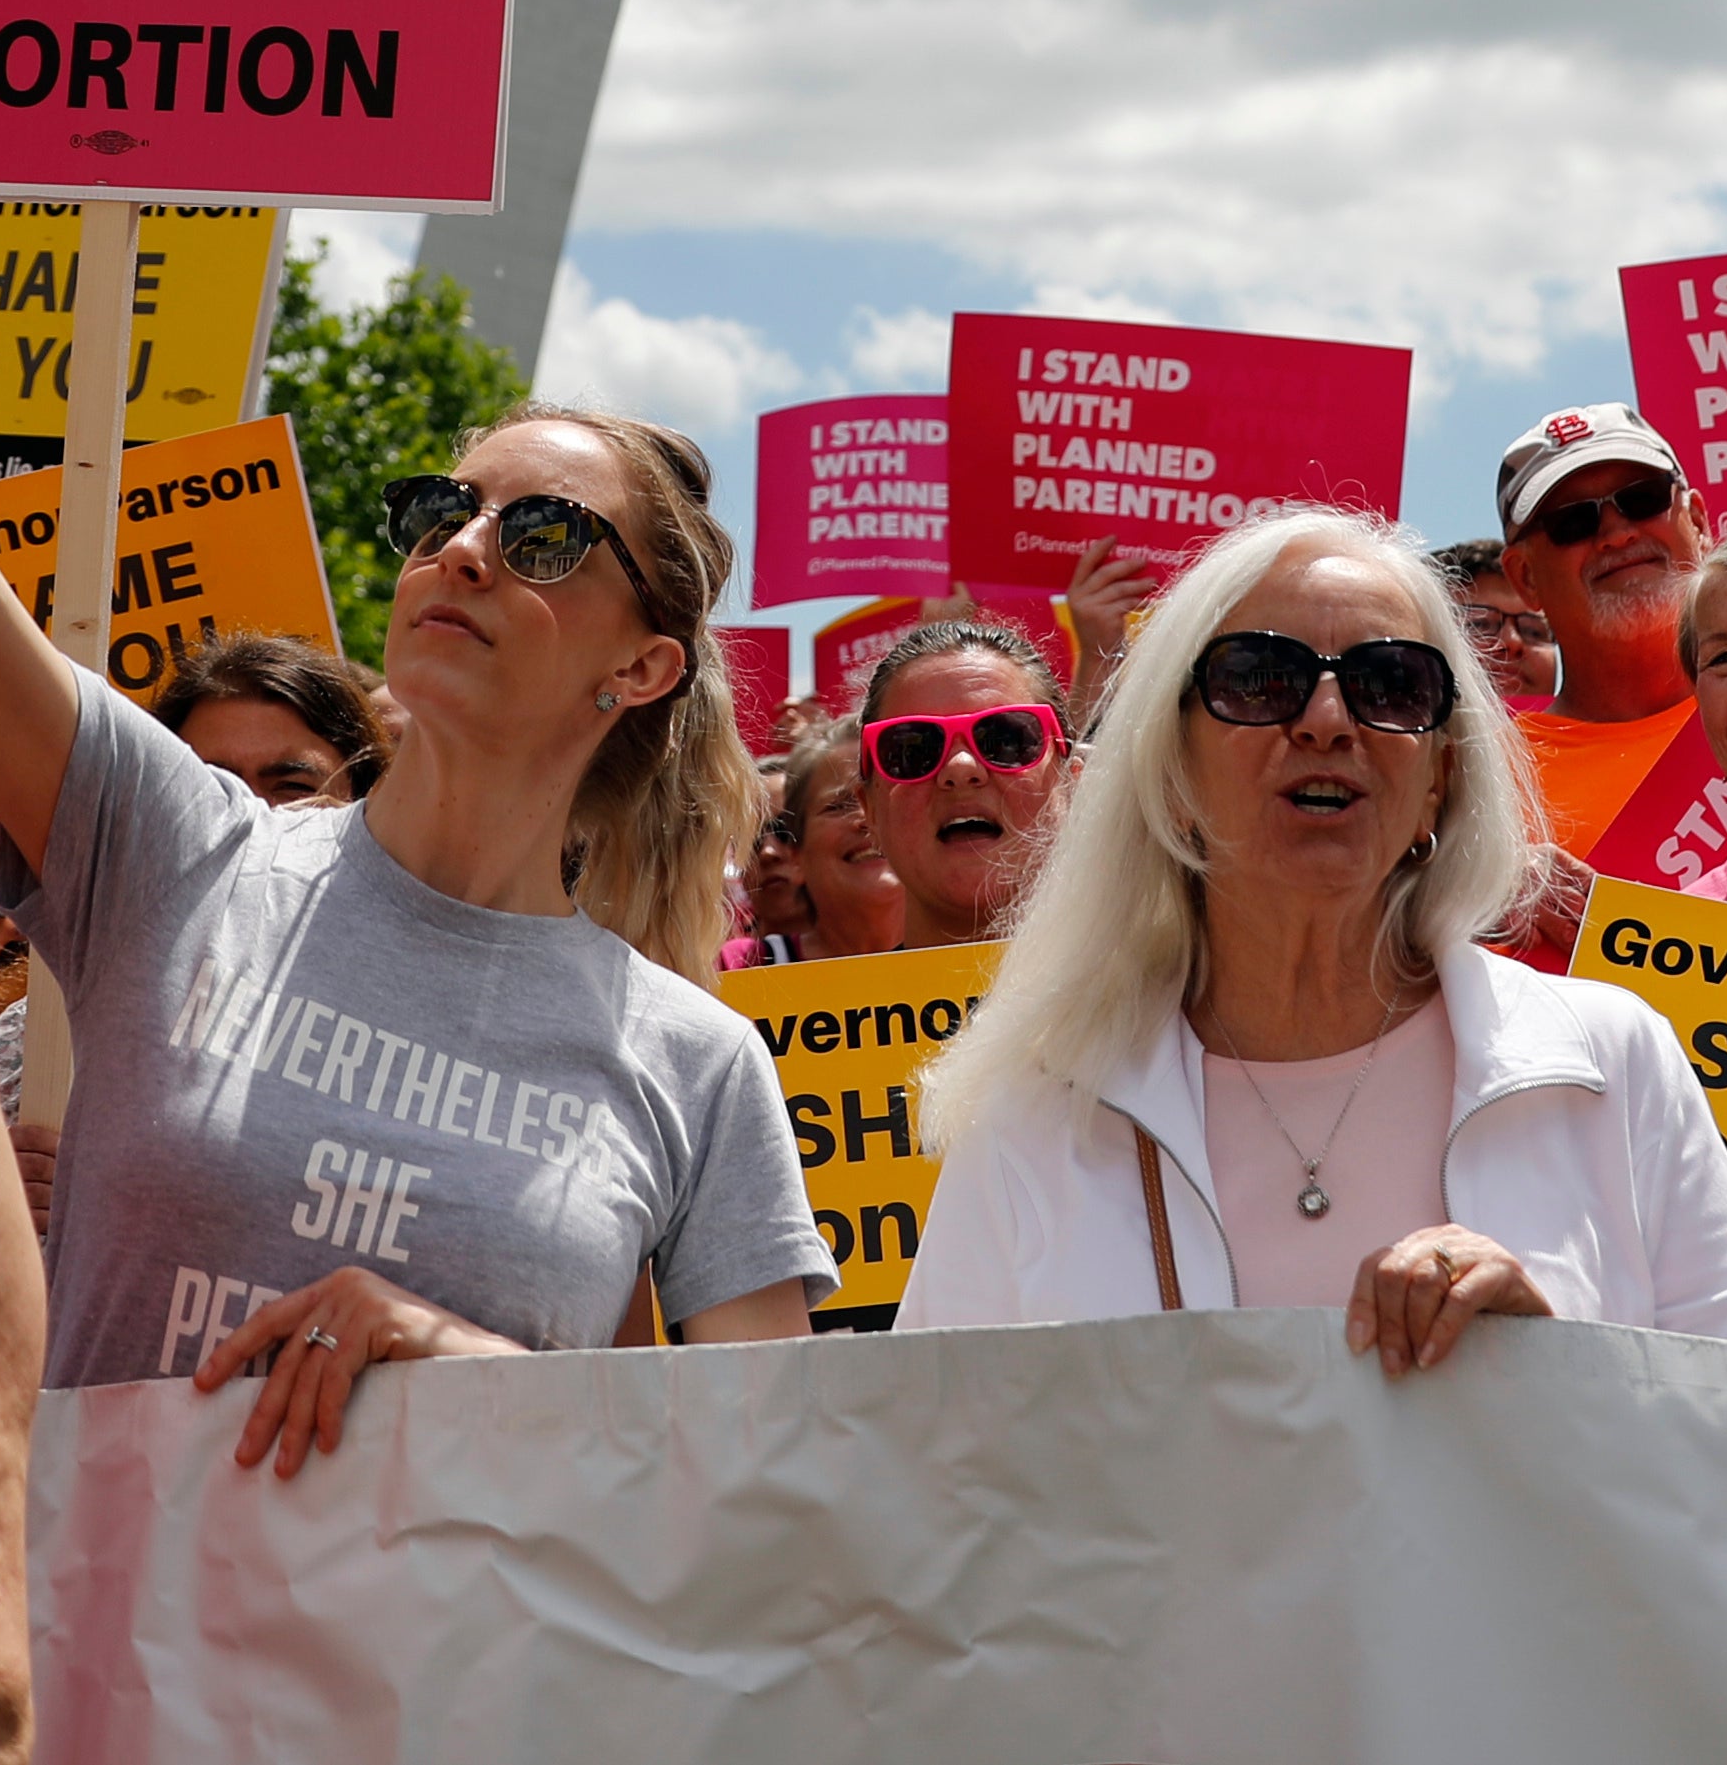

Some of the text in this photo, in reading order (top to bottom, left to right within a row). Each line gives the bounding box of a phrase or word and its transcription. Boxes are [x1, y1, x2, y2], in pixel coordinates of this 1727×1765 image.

[1677, 278, 1701, 322] I
[1018, 347, 1192, 392] I STAND
[1017, 391, 1133, 431] WITH
[809, 417, 949, 451] I STAND
[4, 456, 35, 479] lie
[810, 449, 907, 481] WITH
[1012, 433, 1217, 482] PLANNED
[119, 456, 281, 523] arson
[808, 480, 949, 512] PLANNE
[1012, 475, 1291, 528] PARENTHOO
[808, 511, 950, 544] PARENT
[754, 995, 980, 1059] verno
[168, 958, 615, 1186] NEVERTHELESS
[291, 1138, 433, 1264] SHE
[812, 1201, 919, 1268] on
